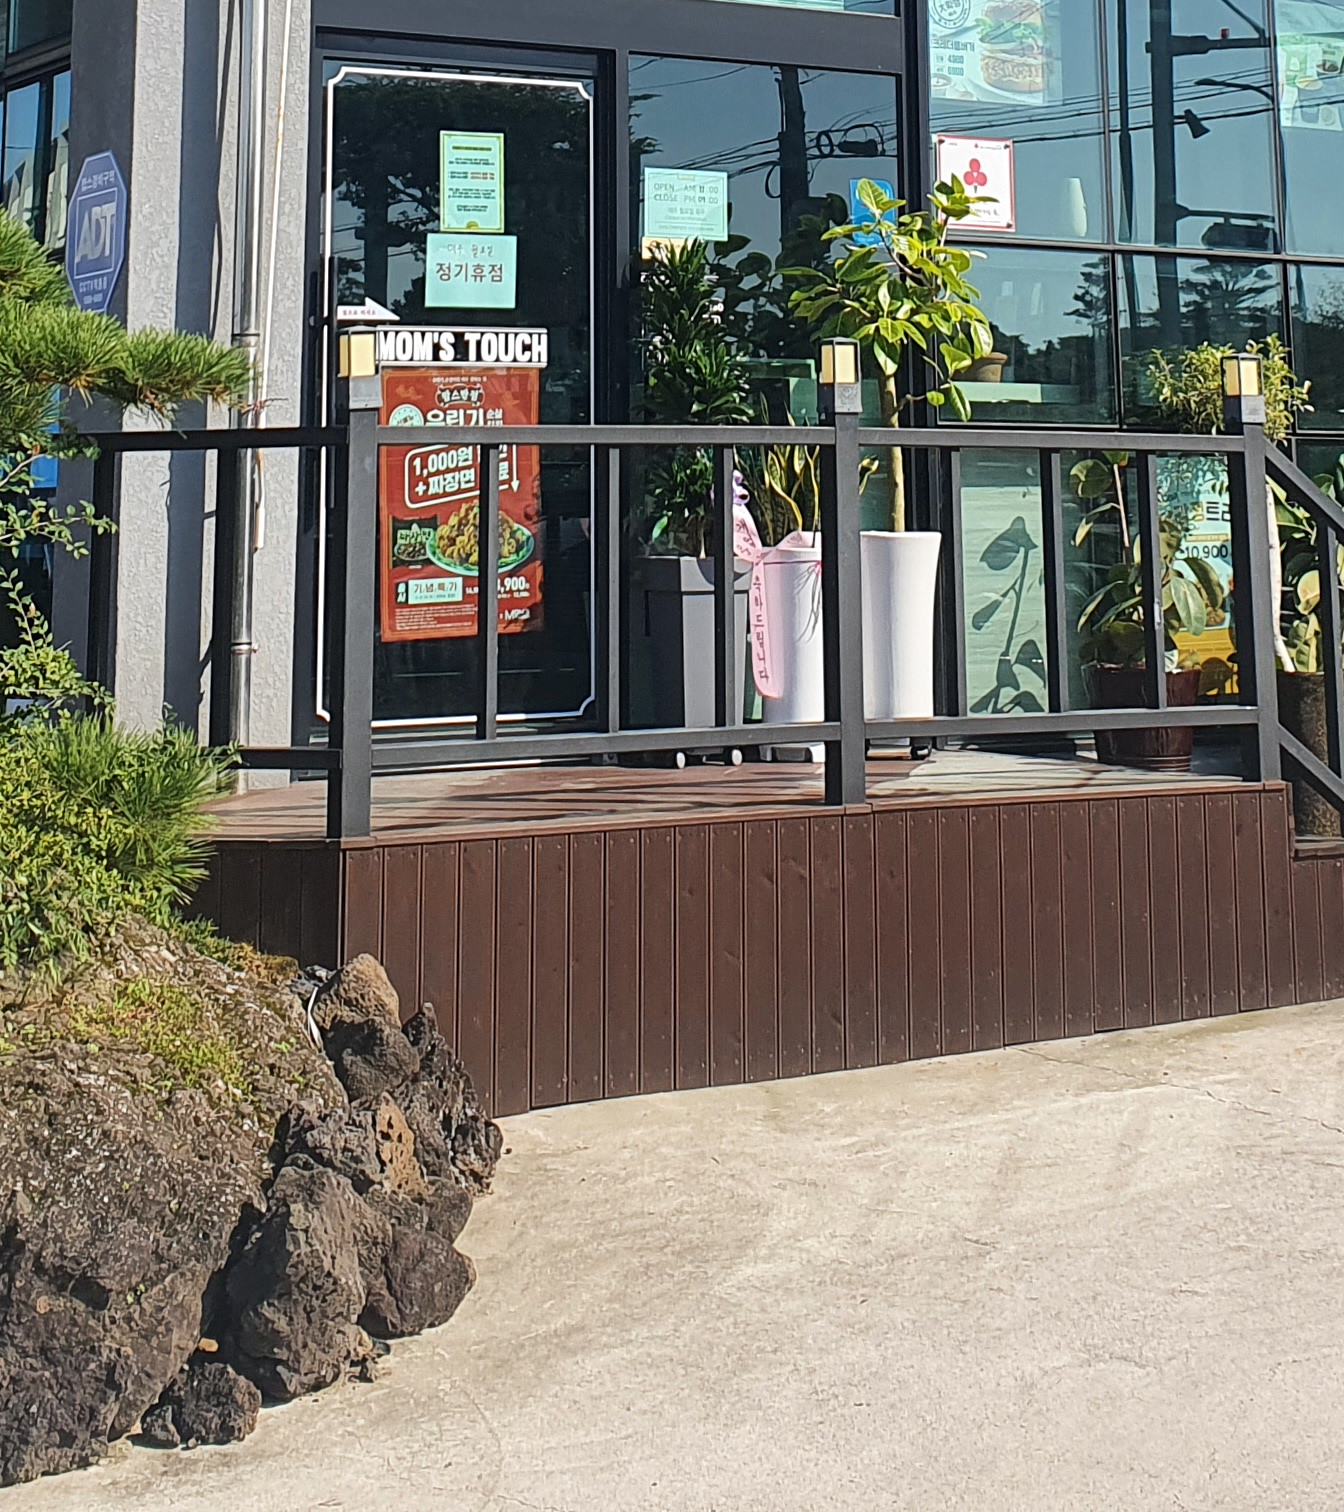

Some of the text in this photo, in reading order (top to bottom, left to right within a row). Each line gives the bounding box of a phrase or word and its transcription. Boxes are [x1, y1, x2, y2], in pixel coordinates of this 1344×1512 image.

[654, 183, 675, 192] OPEN
[654, 193, 678, 202] CLOSE
[684, 195, 697, 203] PM
[76, 201, 116, 263] ADT
[471, 244, 494, 257] 월요일
[435, 262, 504, 283] 정기휴점
[379, 331, 547, 363] MOM'S TOUCH
[413, 445, 473, 478] 1,000원
